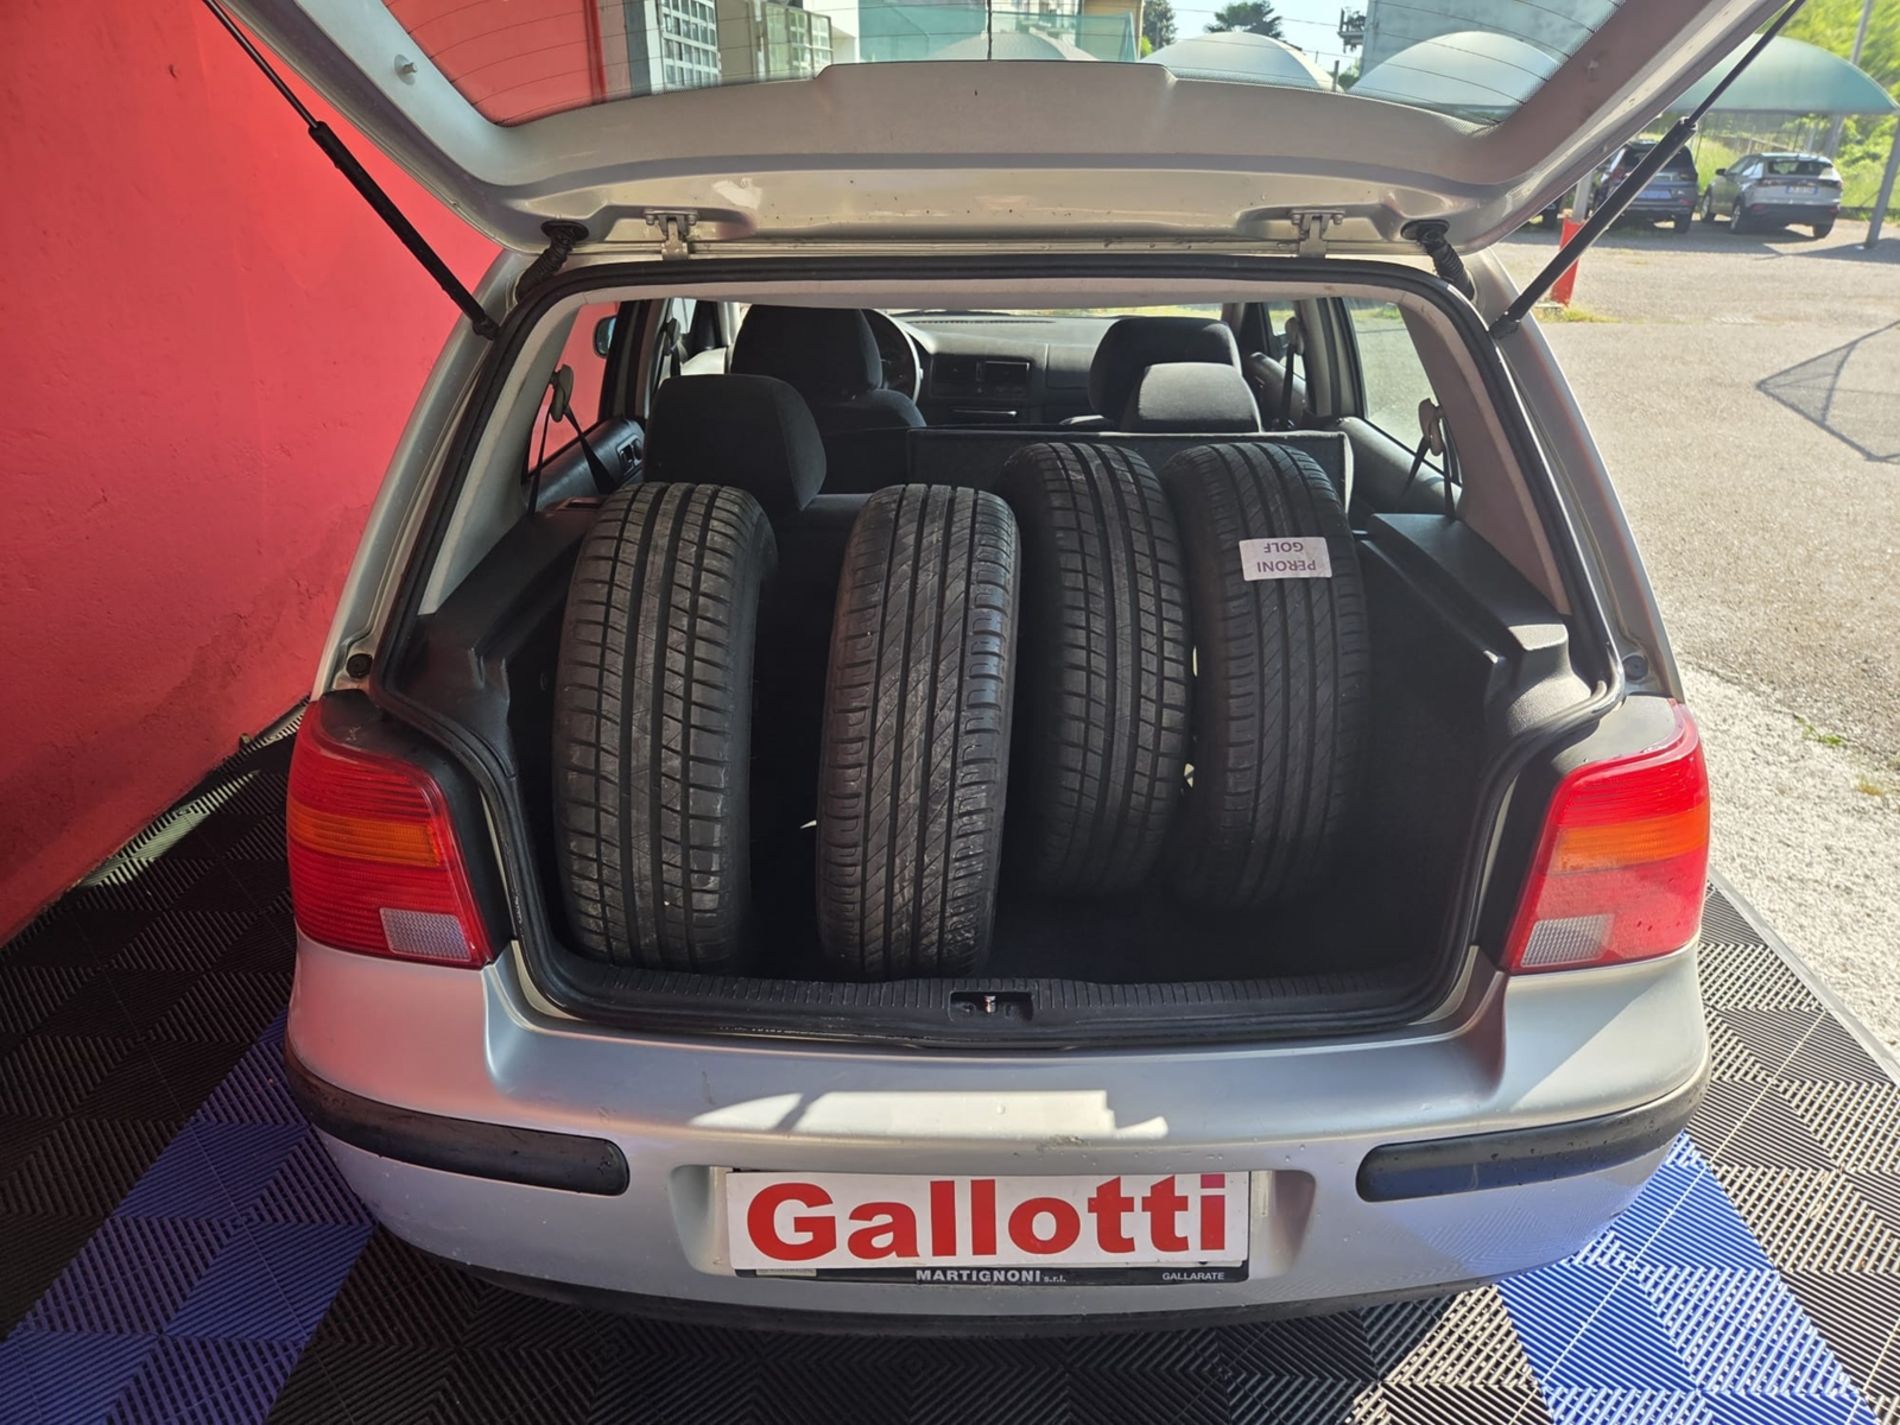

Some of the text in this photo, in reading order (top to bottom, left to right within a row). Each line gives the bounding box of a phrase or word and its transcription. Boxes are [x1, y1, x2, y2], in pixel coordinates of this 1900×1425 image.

[1263, 541, 1304, 553] GOLF
[1257, 560, 1316, 573] PERONI
[747, 1173, 1226, 1261] Gallotti
[915, 1269, 1067, 1283] MARTIGNONI s.r.l.
[1162, 1271, 1225, 1281] GALLARATE
